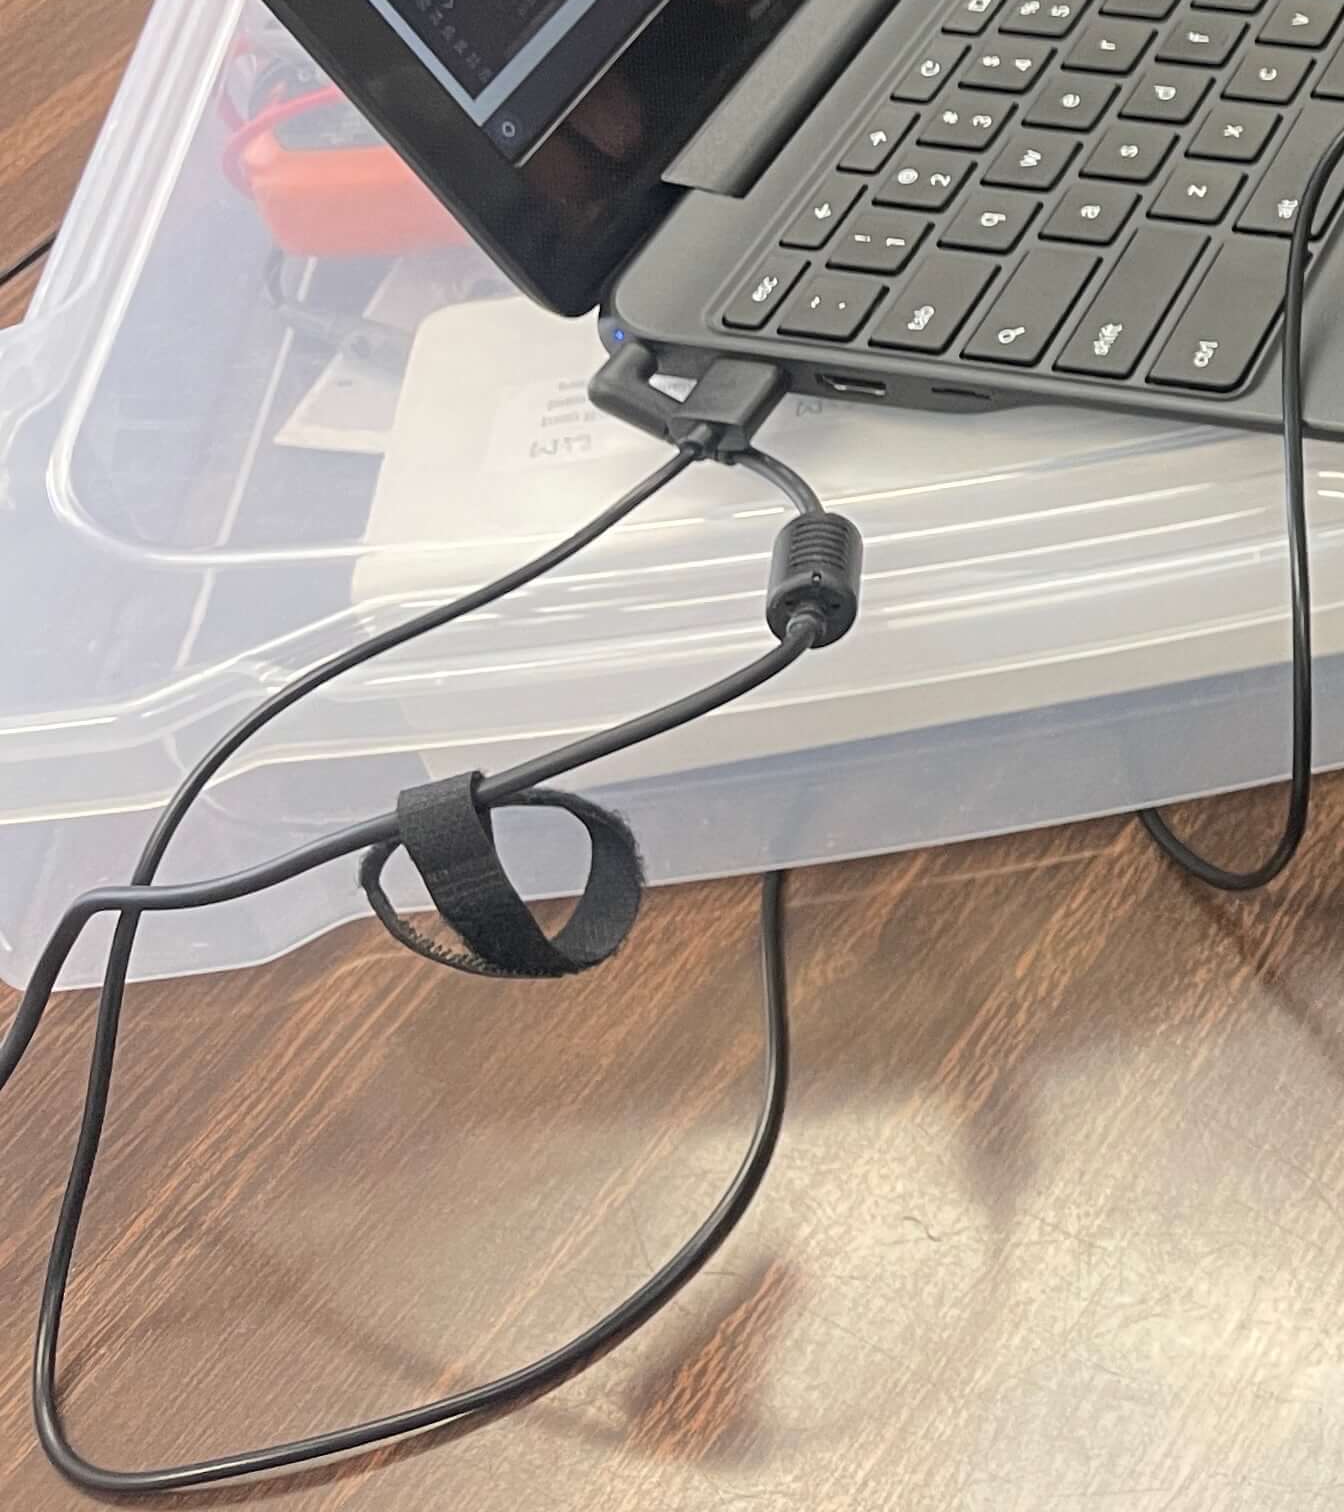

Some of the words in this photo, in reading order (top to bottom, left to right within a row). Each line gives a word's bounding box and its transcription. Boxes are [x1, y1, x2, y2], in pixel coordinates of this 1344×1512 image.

[1020, 0, 1040, 16] %
[1050, 5, 1070, 18] 5
[1291, 13, 1309, 26] v
[1188, 31, 1209, 43] f
[1100, 39, 1116, 50] r
[1014, 59, 1032, 72] 4
[1259, 67, 1277, 81] c
[1153, 85, 1177, 101] d
[1062, 94, 1081, 108] e
[972, 115, 992, 128] 3
[1223, 124, 1243, 138] x
[1019, 149, 1042, 167] w
[1119, 145, 1139, 158] s
[897, 168, 919, 185] @
[930, 173, 951, 187] 2
[1187, 184, 1207, 198] z
[1080, 205, 1101, 219] a
[1277, 198, 1298, 220] alt
[980, 212, 1006, 227] q
[885, 237, 905, 247] 1
[907, 305, 935, 330] tab
[1093, 323, 1123, 356] shift
[1193, 340, 1218, 368] ctrl
